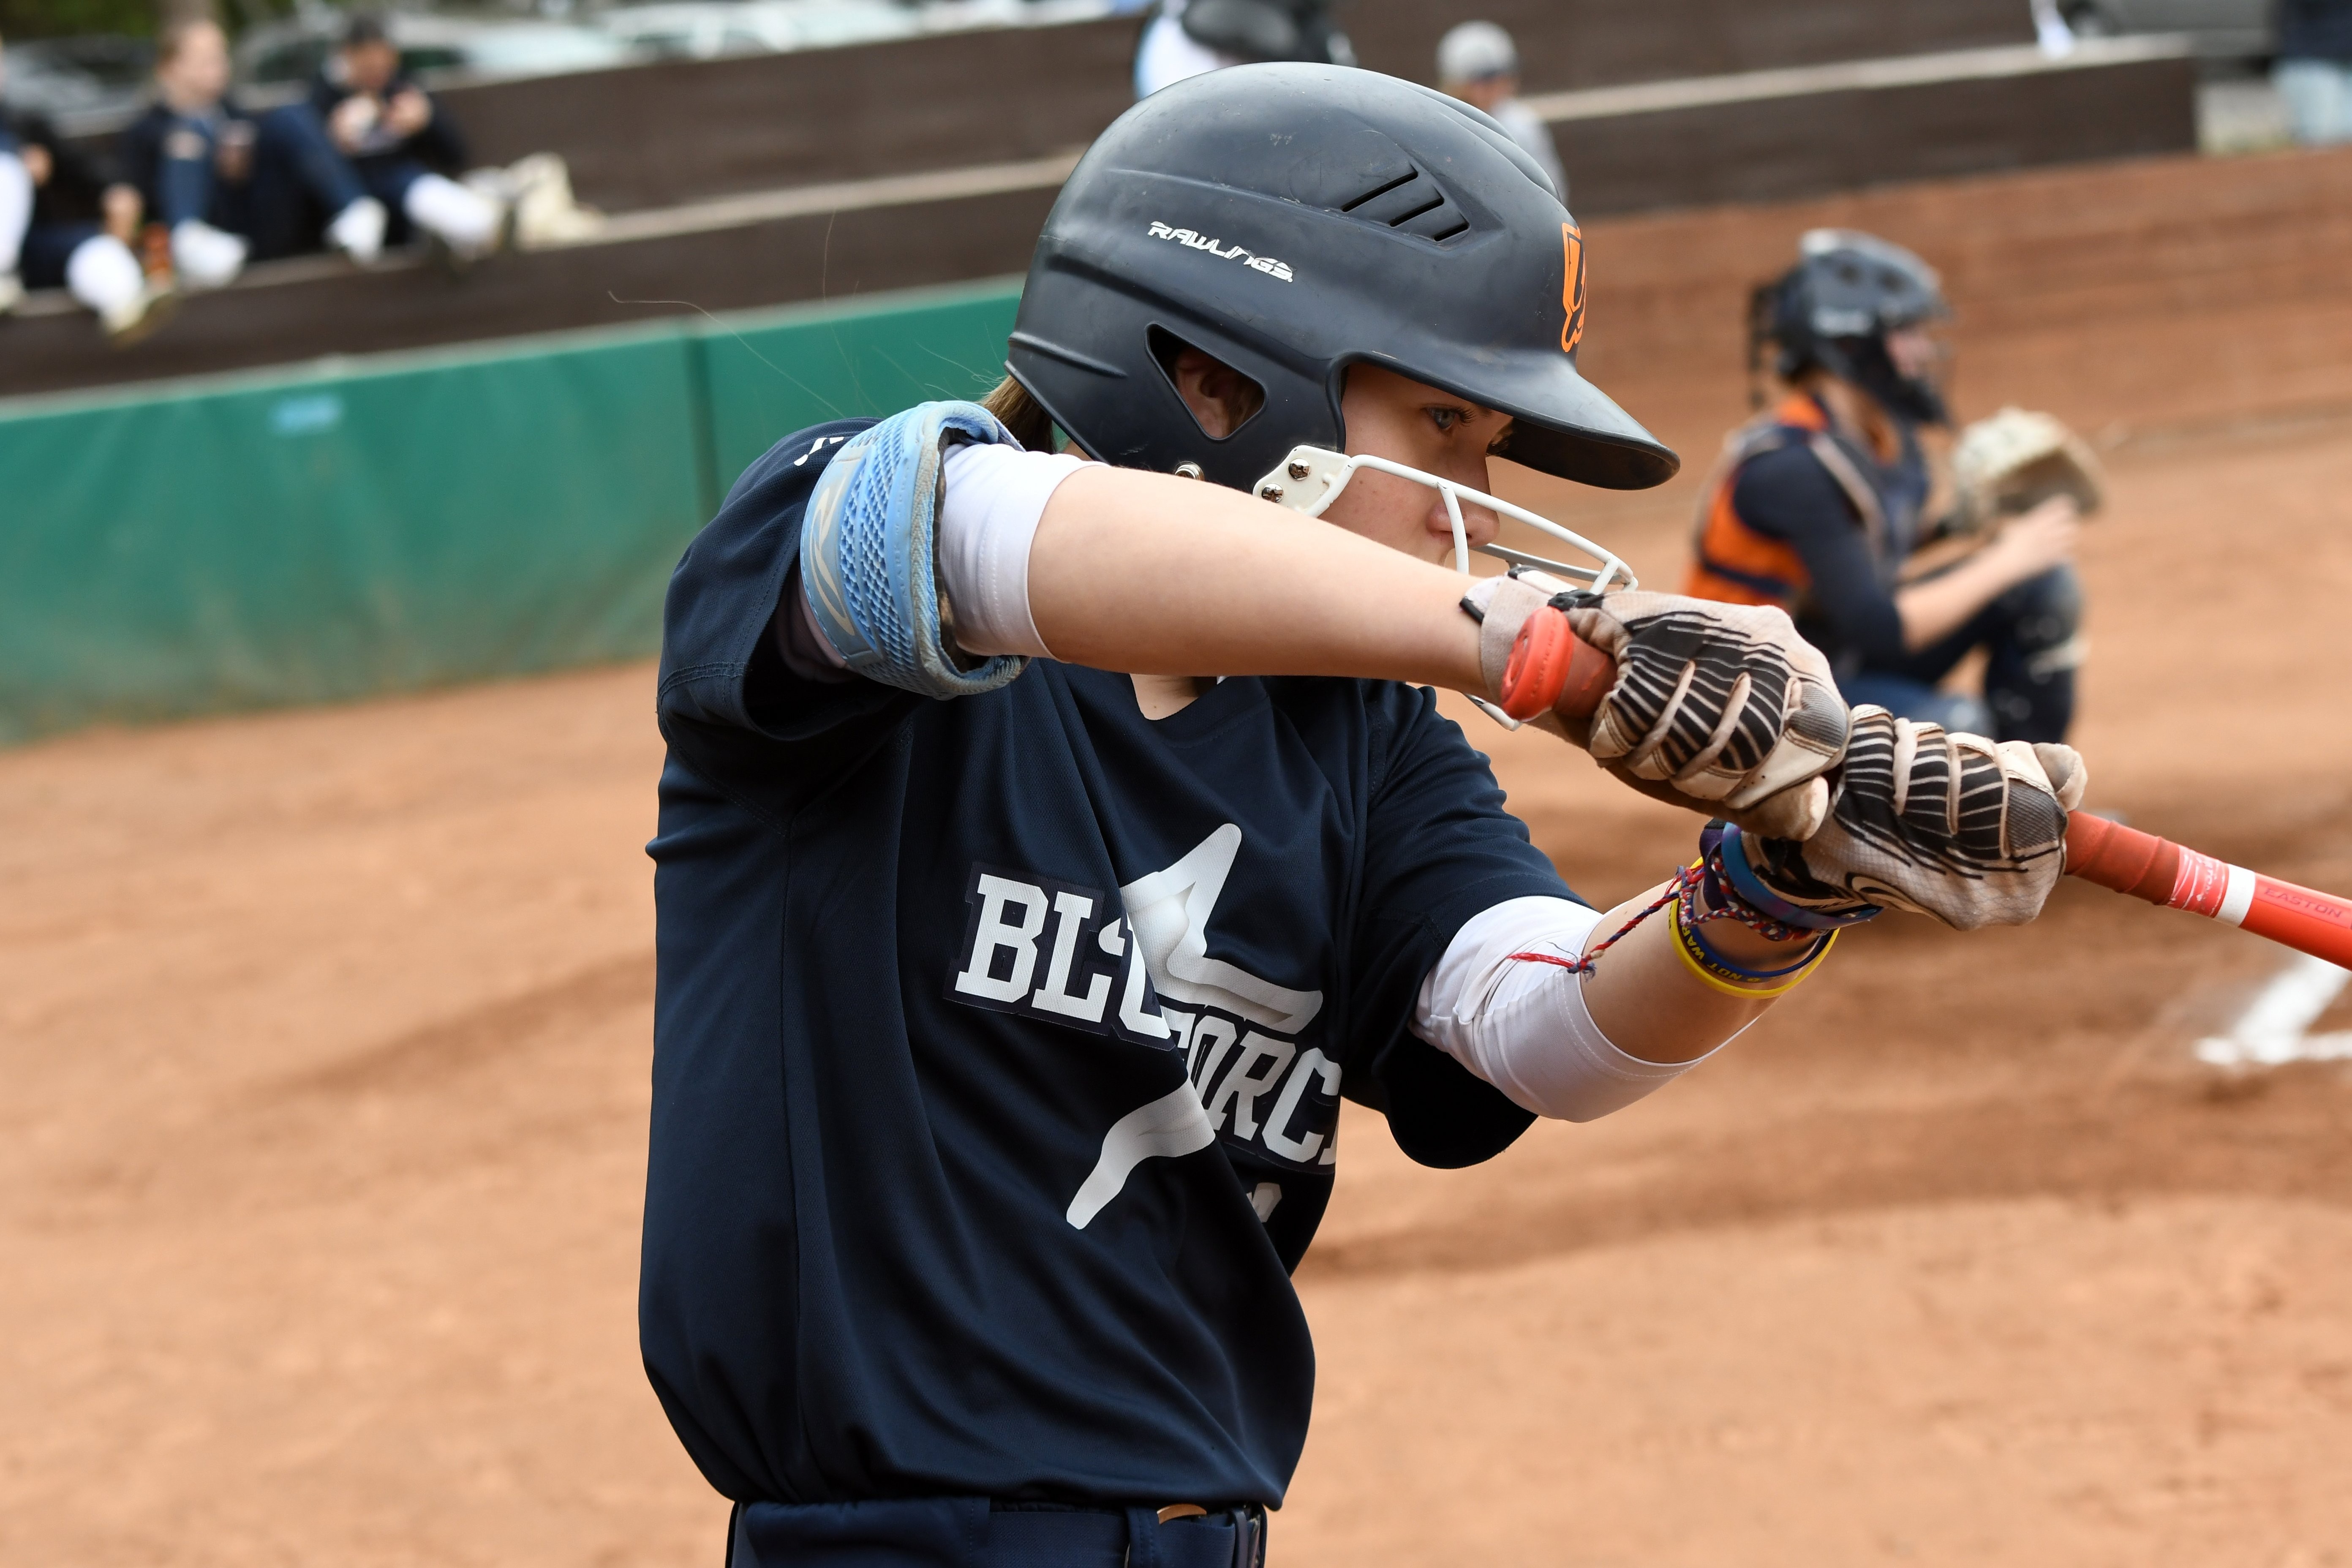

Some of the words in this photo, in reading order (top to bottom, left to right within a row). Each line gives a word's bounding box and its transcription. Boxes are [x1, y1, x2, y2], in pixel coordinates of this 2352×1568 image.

[1147, 220, 1293, 280] RAWLINGS
[2264, 888, 2343, 918] EASTON
[1707, 963, 1742, 981] NOT
[1160, 1005, 1342, 1165] ORC
